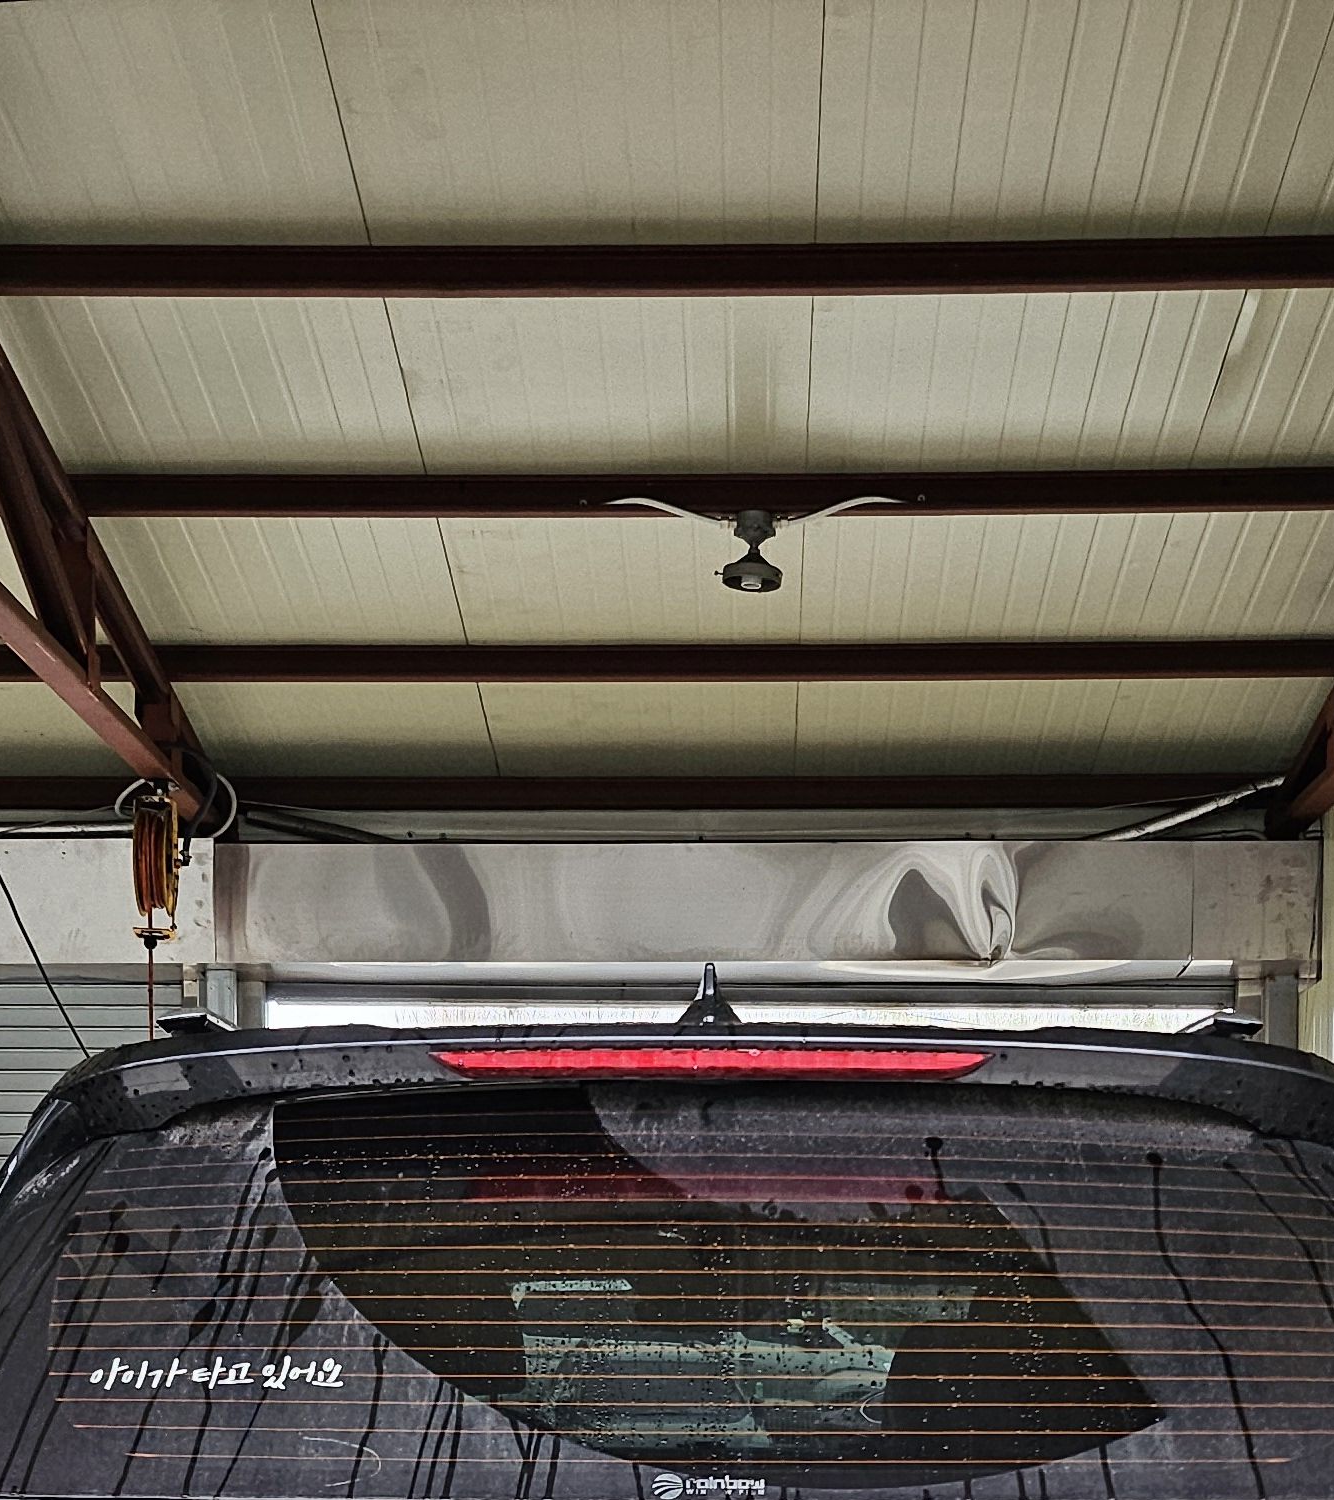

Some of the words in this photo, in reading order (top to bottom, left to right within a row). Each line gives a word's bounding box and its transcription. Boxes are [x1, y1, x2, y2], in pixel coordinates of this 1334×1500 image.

[89, 1356, 188, 1391] 아이가
[190, 1355, 255, 1390] 타고
[261, 1354, 345, 1390] 있어요
[685, 1474, 766, 1490] rainbow
